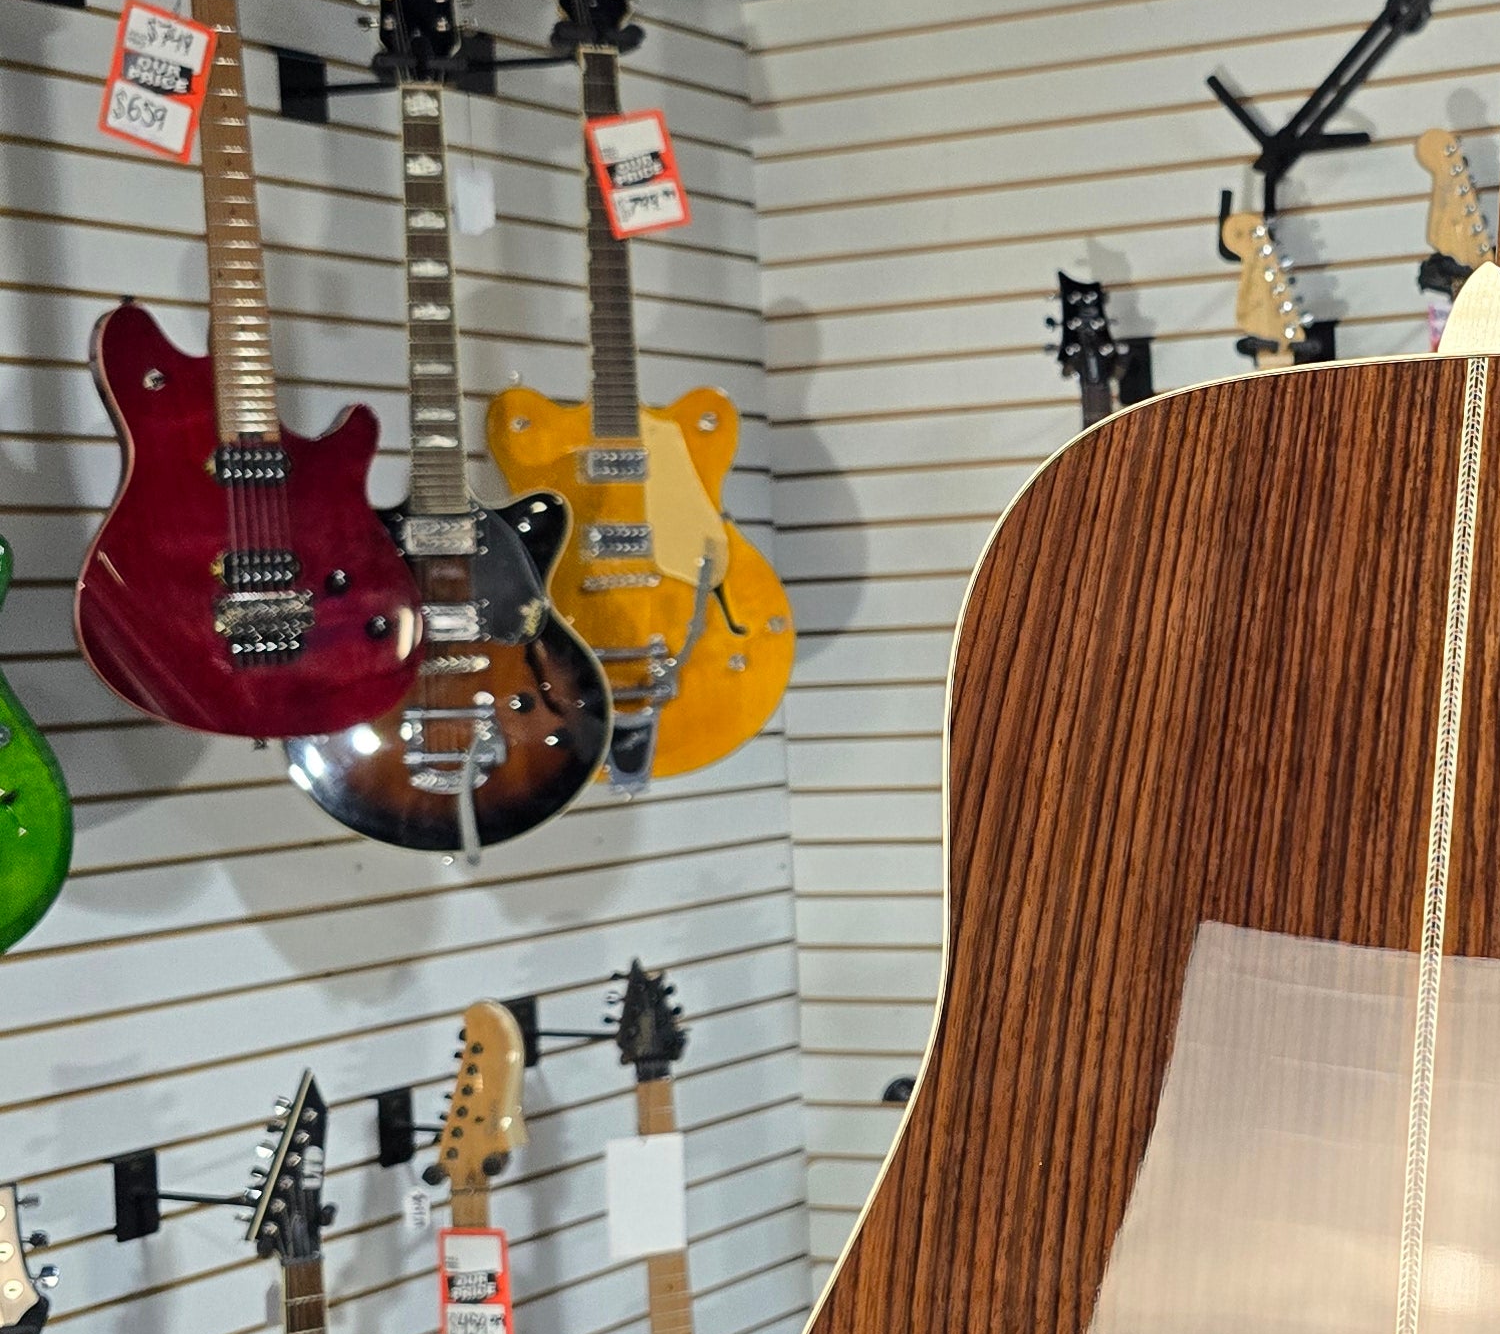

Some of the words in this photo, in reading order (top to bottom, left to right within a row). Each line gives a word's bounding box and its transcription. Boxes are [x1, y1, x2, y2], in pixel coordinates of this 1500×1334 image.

[136, 56, 182, 77] OUR
[127, 65, 190, 94] PRICE
[613, 162, 665, 186] PRICE
[617, 154, 654, 175] OUR
[455, 1272, 489, 1288] OUR
[449, 1281, 498, 1302] PRICE
